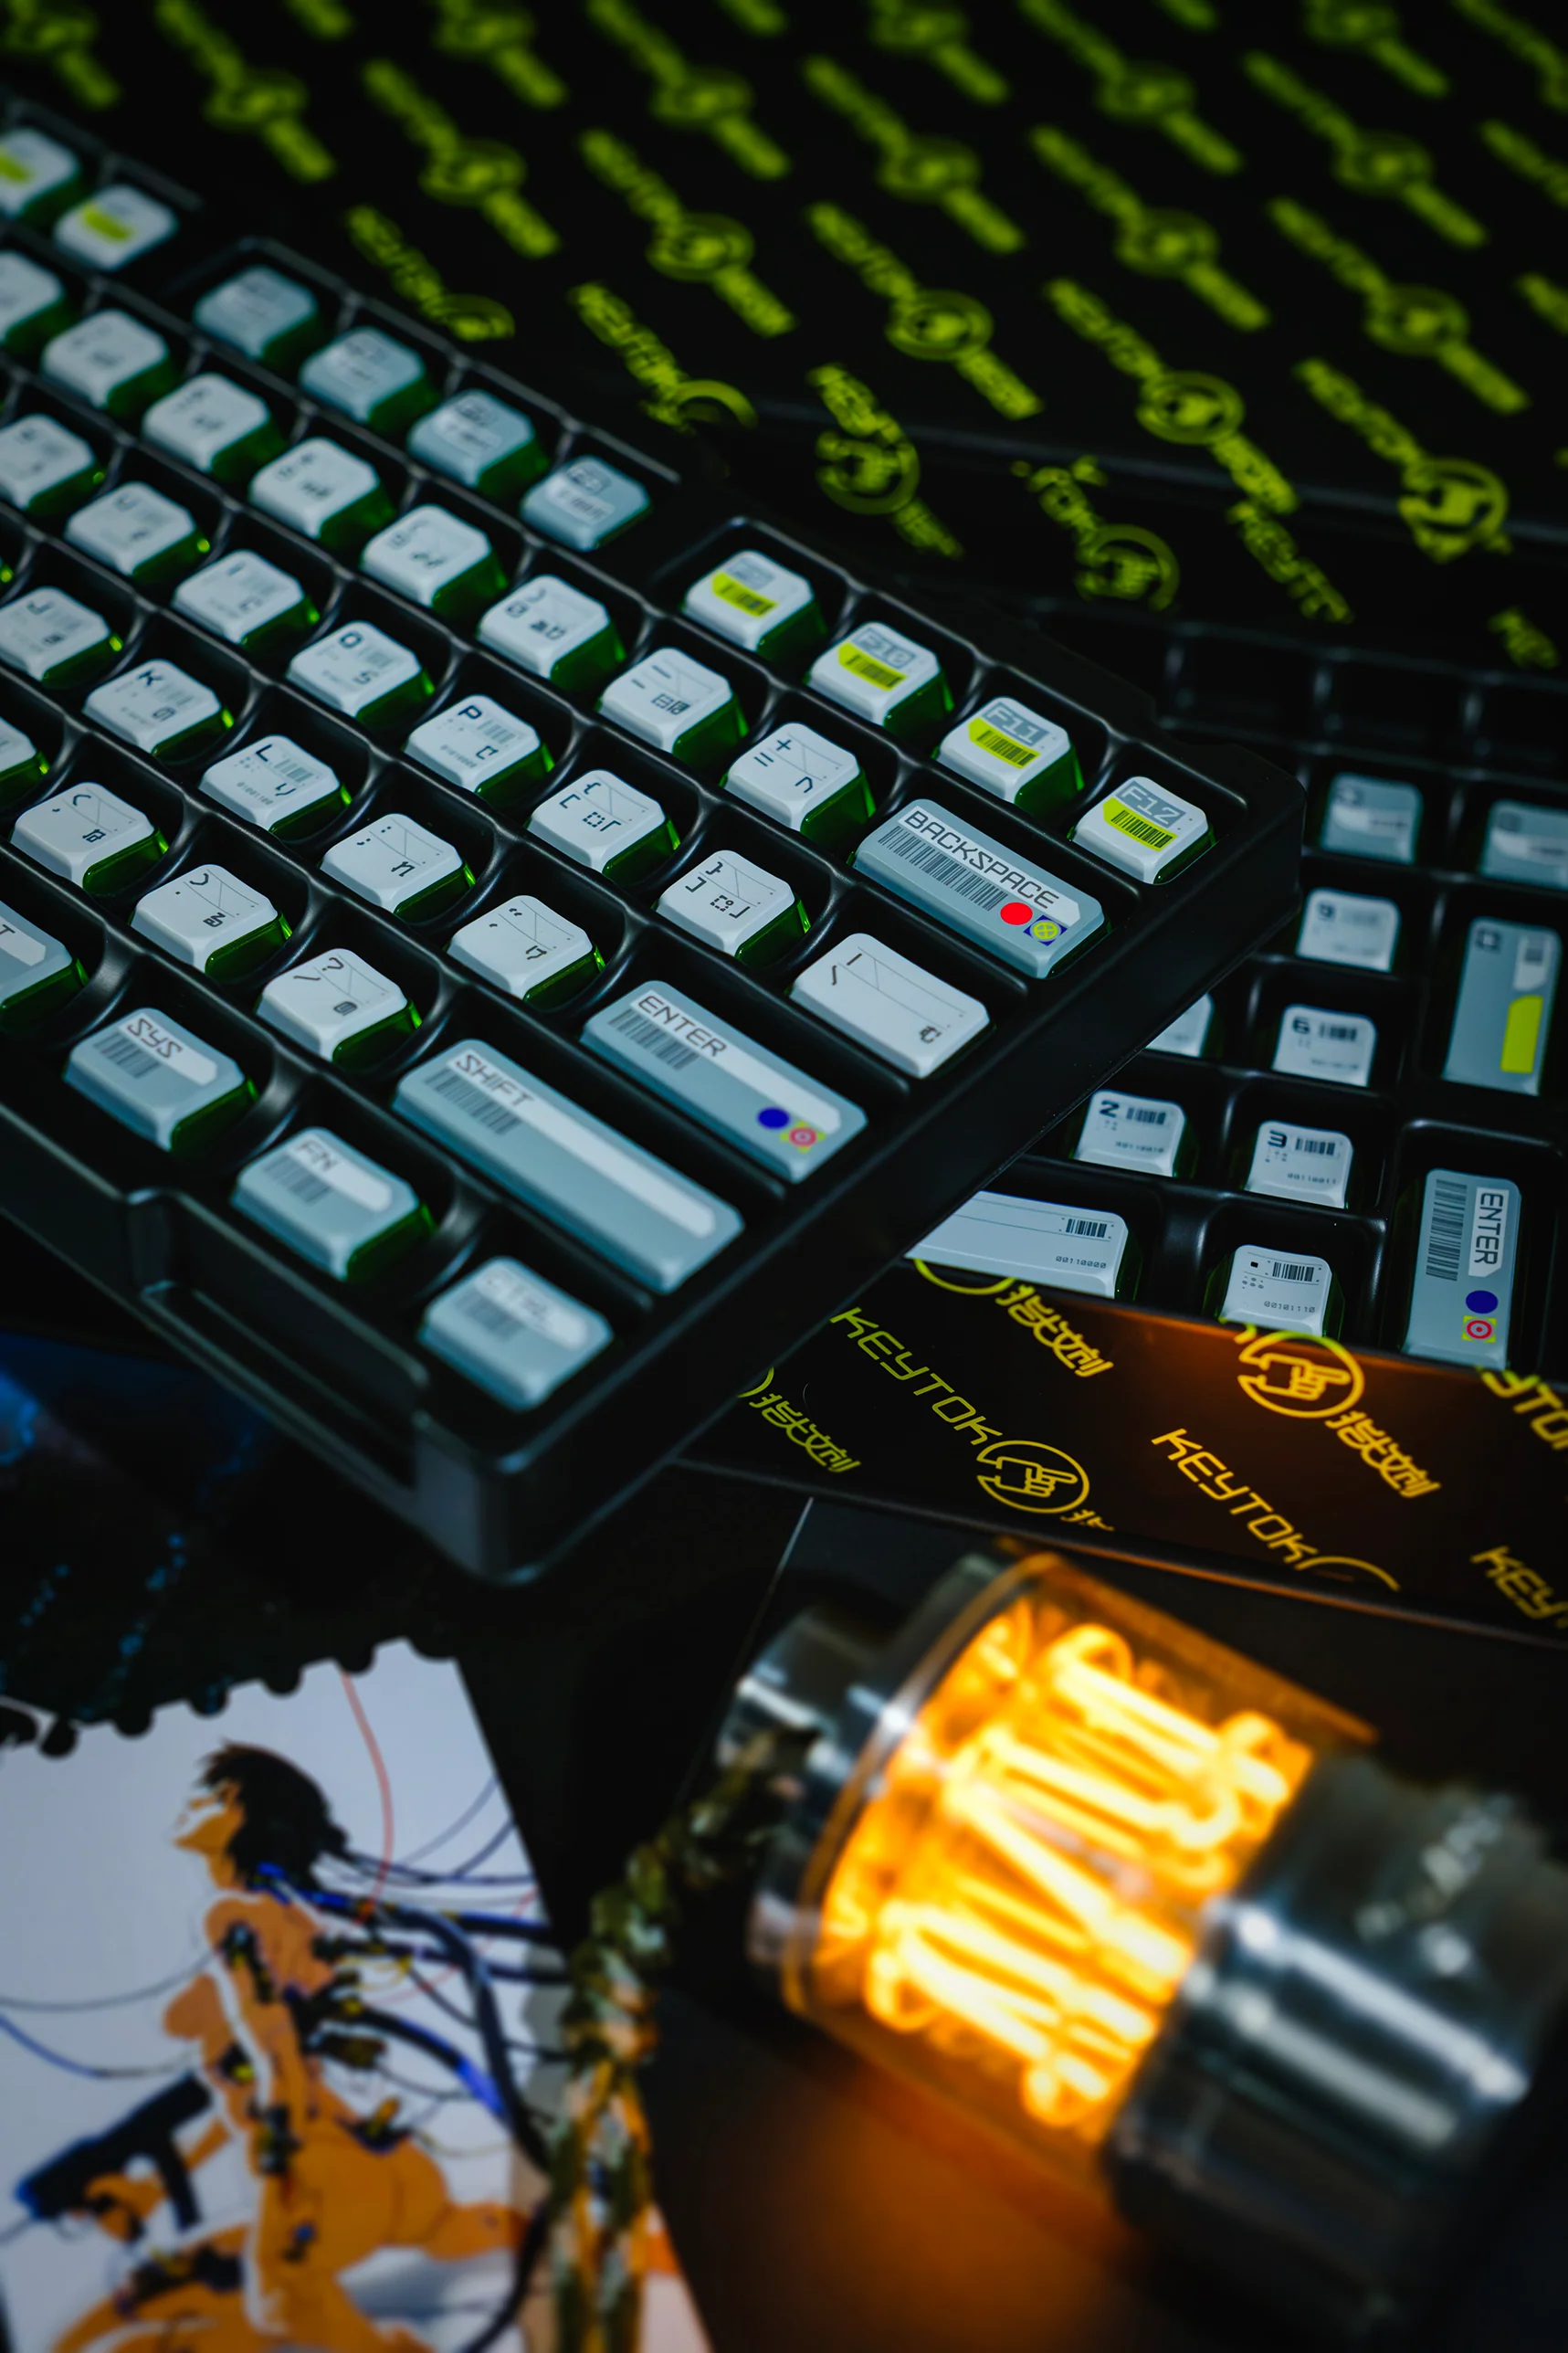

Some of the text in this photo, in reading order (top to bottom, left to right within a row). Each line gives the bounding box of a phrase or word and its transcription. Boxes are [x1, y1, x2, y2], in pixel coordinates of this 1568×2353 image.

[458, 704, 483, 720] P
[987, 707, 1045, 745] F11
[255, 743, 273, 763] L
[1121, 786, 1184, 827] F12
[904, 810, 1060, 910] BACKSPACE
[127, 1018, 183, 1060] SYS
[639, 996, 727, 1059] ENTER
[456, 1053, 535, 1107] SHIFT
[1099, 1100, 1120, 1119] 2
[295, 1138, 343, 1174] FN
[1267, 1129, 1288, 1149] 3
[1474, 1191, 1505, 1266] ENTER
[1055, 1254, 1108, 1269] 00110000
[1264, 1300, 1317, 1314] 00101110
[829, 1306, 1004, 1446] KEYTOK
[1151, 1428, 1319, 1564] KEYTOK
